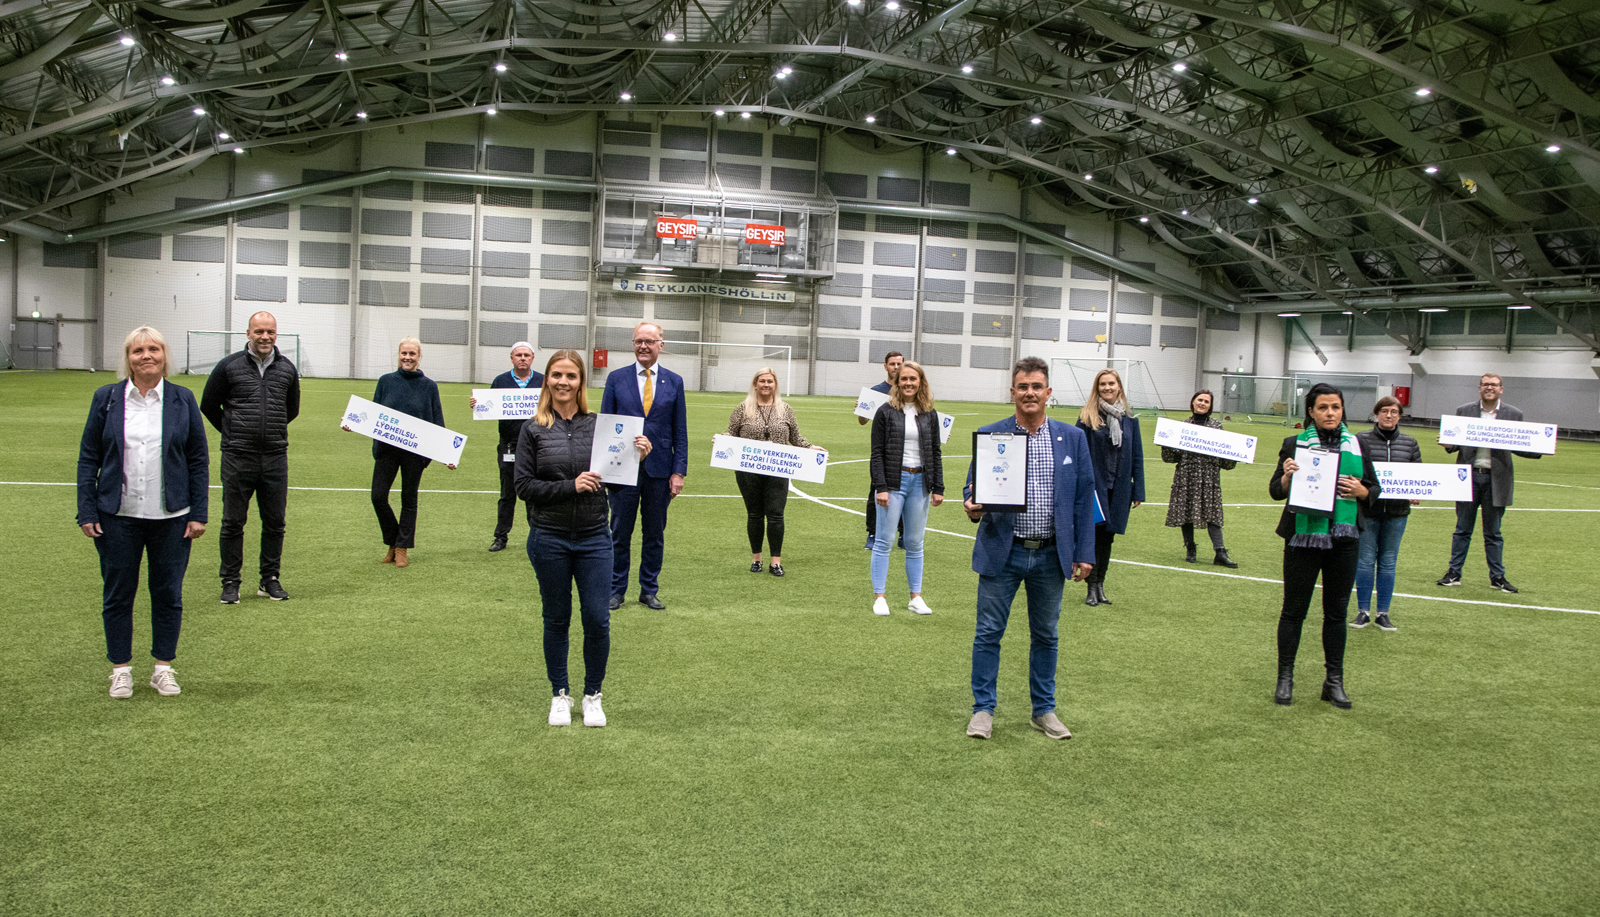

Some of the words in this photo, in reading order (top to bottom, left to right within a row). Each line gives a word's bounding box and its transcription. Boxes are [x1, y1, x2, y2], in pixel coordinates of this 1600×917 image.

[656, 221, 697, 236] GEYSIR
[746, 227, 785, 242] GEYSIR
[634, 282, 787, 301] REYKJANESHÖLLIN
[502, 394, 512, 402] ÉG
[378, 412, 389, 422] ÉG
[389, 417, 400, 425] ER
[502, 409, 535, 417] FULLTRÚI
[375, 420, 418, 440] LÝÐHEILSU-
[373, 428, 419, 449] FRÆÐINGUR
[1180, 434, 1232, 449] VERKEFNASTJÓRI
[742, 445, 752, 453] ÉG
[762, 449, 800, 461] VERKEFNA-
[740, 461, 755, 469] SEM
[756, 462, 776, 472] ÖÐRU
[776, 465, 795, 475] MÁLI
[741, 453, 765, 462] STJÓRI
[769, 457, 803, 469] ÍSLENSKU
[1381, 479, 1441, 487] RNAVERNDAR-
[1380, 487, 1433, 495] ARFSMAÐUR
